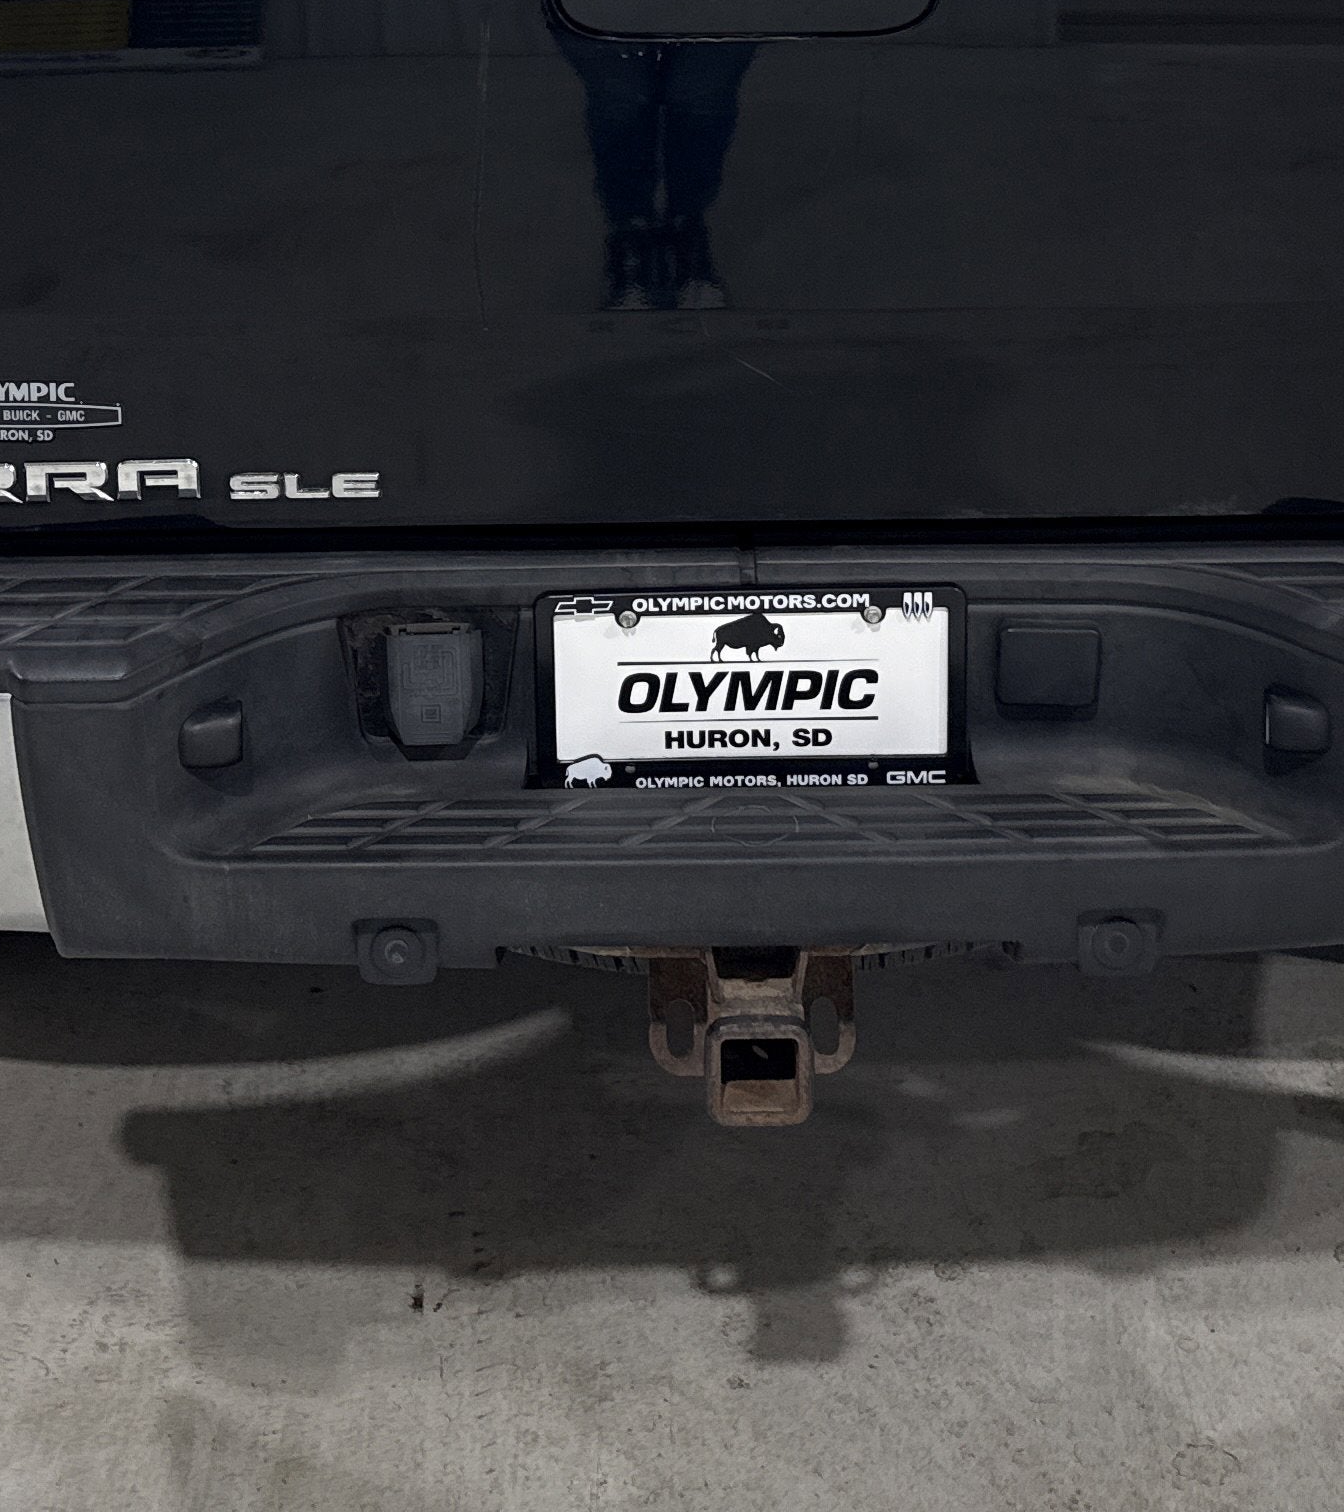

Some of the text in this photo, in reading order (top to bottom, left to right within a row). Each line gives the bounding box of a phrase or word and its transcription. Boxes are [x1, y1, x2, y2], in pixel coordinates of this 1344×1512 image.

[3, 409, 40, 422] BUICK
[57, 409, 85, 422] GMC
[37, 429, 53, 442] SD
[228, 472, 383, 499] SLE
[617, 669, 878, 713] OLYMPIC
[665, 728, 832, 751] HURON, SD
[635, 773, 868, 789] OLYMPIC MOTORS, HURON SD
[886, 770, 946, 784] GMC
